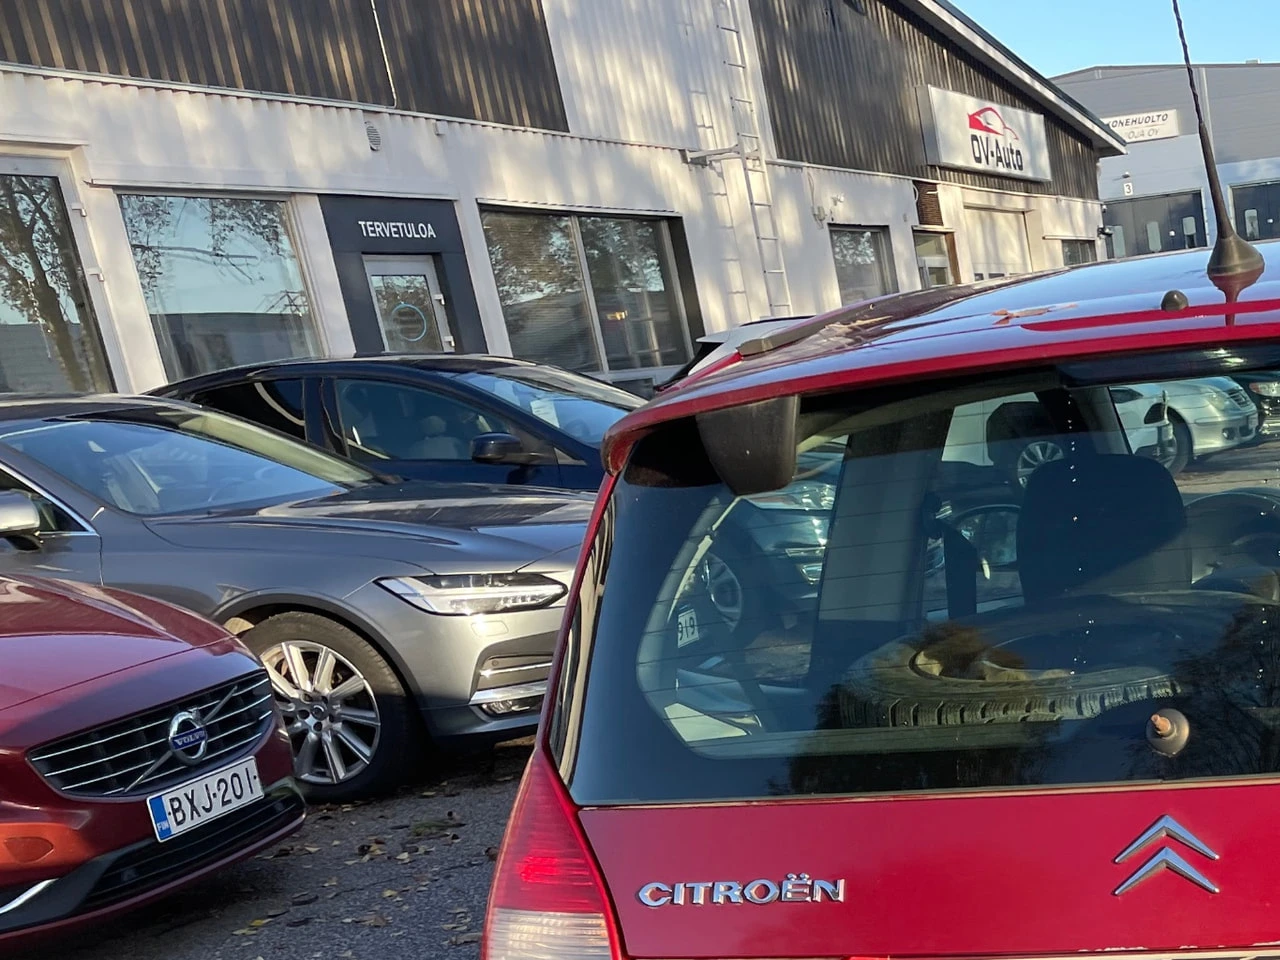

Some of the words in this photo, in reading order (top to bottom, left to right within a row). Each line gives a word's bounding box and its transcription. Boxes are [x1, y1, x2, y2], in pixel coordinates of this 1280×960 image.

[1108, 113, 1169, 128] ONEHUOLTO
[1125, 184, 1132, 194] 3
[358, 221, 437, 239] TERVETULOA
[174, 729, 206, 747] VOLVO
[168, 768, 255, 828] BXJ-201
[637, 872, 846, 908] CITROËN
